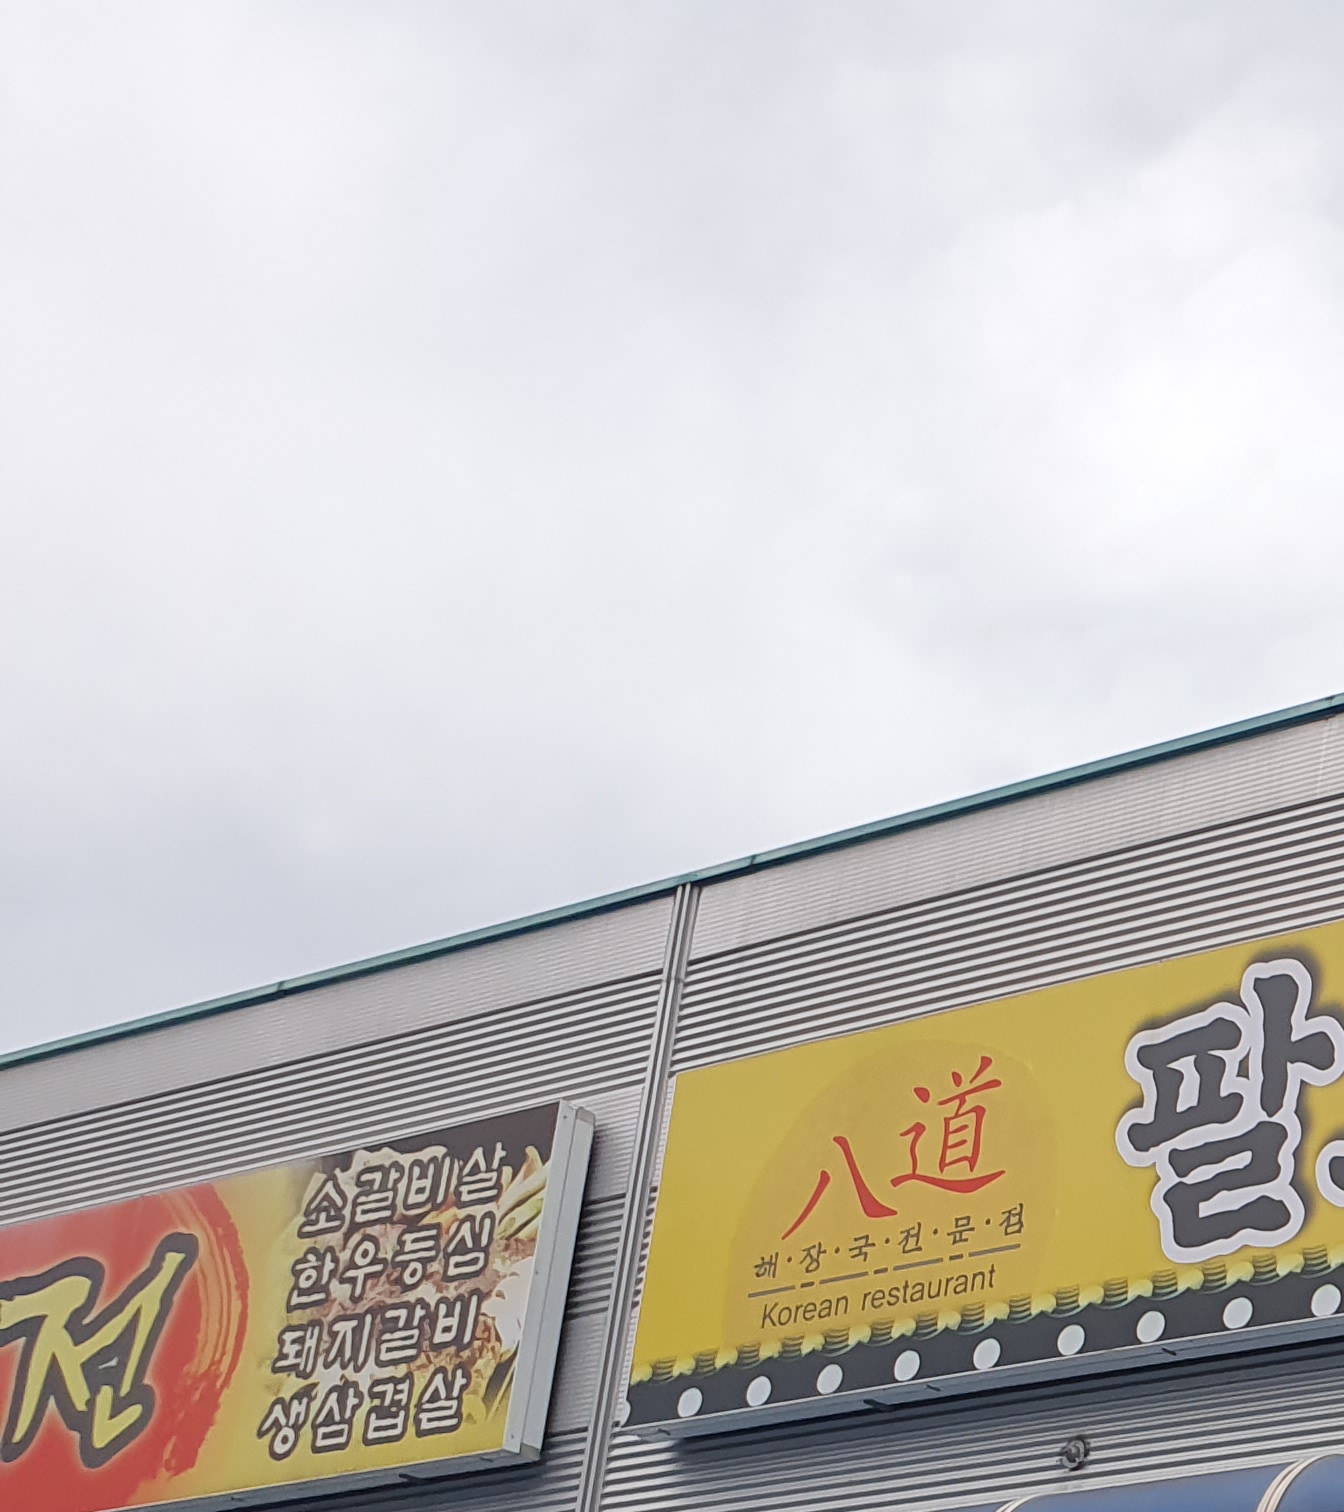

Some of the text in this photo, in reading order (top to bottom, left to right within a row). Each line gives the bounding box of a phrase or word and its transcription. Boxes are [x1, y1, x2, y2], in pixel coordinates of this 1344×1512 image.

[297, 1141, 508, 1238] 소갈비살
[781, 1055, 1007, 1240] 八道
[288, 1213, 494, 1310] 한우등심
[761, 1263, 997, 1330] Korean restaurant
[273, 1291, 481, 1376] 돼지갈비
[258, 1366, 470, 1459] 생삼겹살
